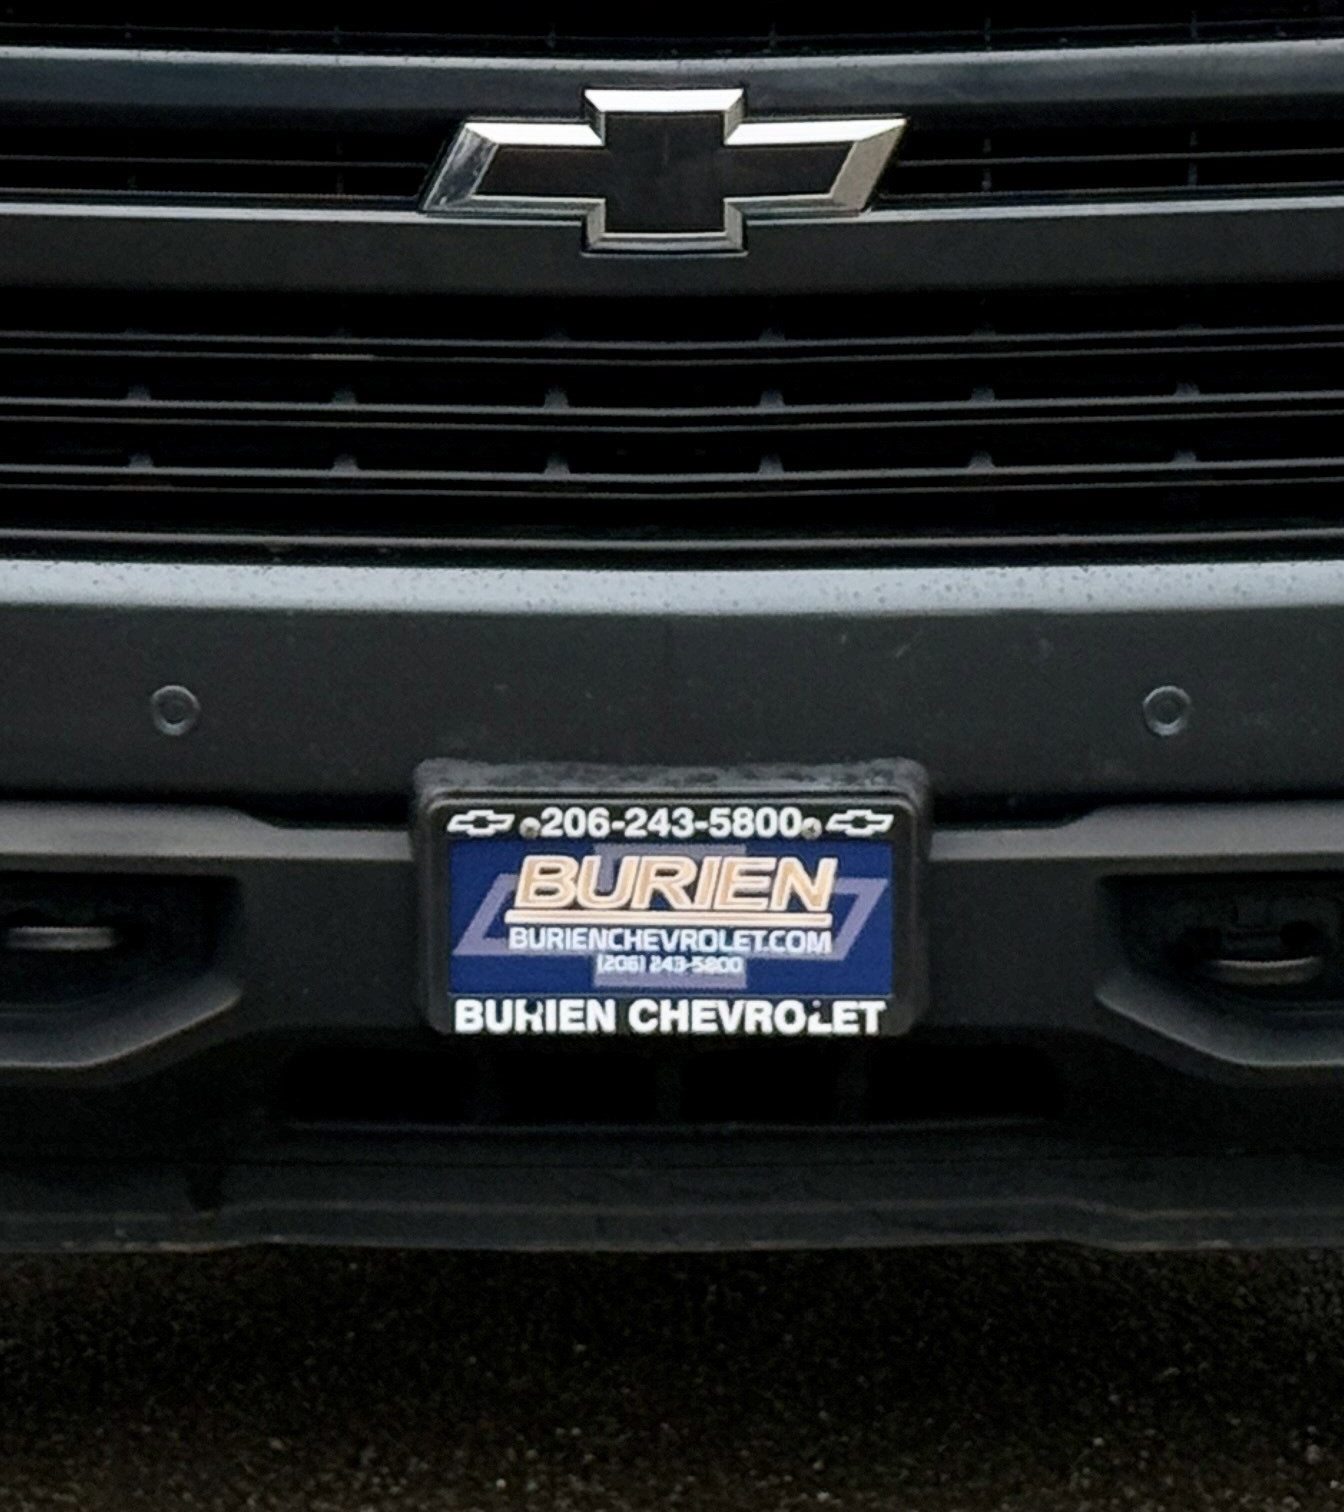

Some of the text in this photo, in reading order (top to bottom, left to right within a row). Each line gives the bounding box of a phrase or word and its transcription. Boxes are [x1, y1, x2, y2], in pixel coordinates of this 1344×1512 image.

[541, 807, 802, 838] 206-243-5800
[515, 854, 838, 912] BURIEN
[509, 927, 832, 953] BURIENCHEVROLET.COM
[597, 955, 646, 974] (206)
[455, 999, 886, 1036] BURIEN CHEVROLET
